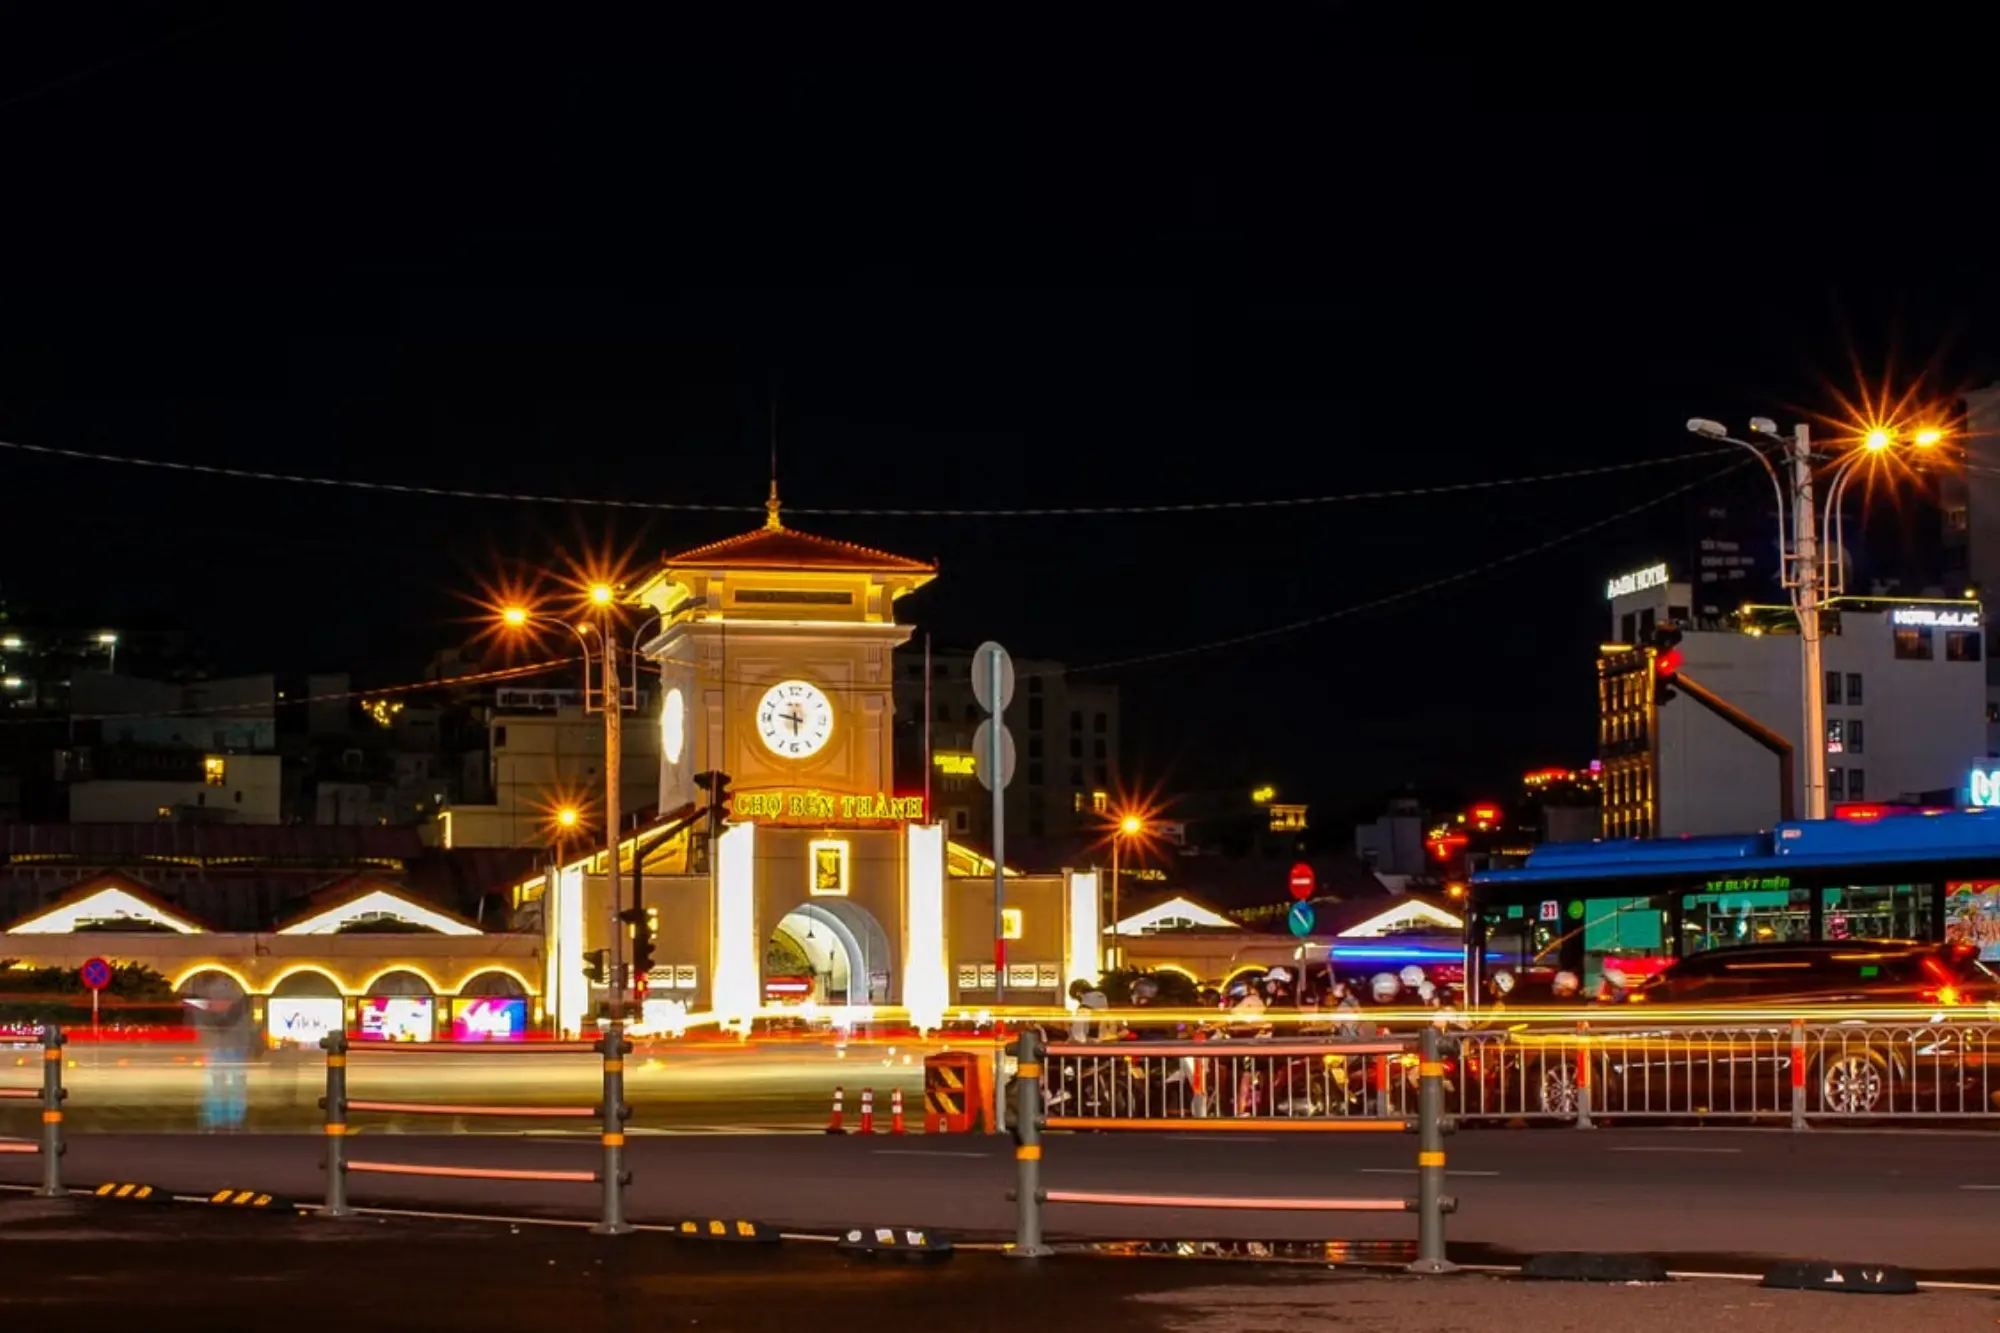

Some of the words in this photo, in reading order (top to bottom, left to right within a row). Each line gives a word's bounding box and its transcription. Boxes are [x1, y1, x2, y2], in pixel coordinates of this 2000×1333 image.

[735, 792, 782, 820] CHỢ
[788, 789, 835, 818] BẾN
[840, 791, 924, 820] THÀNH
[1543, 904, 1555, 917] 31
